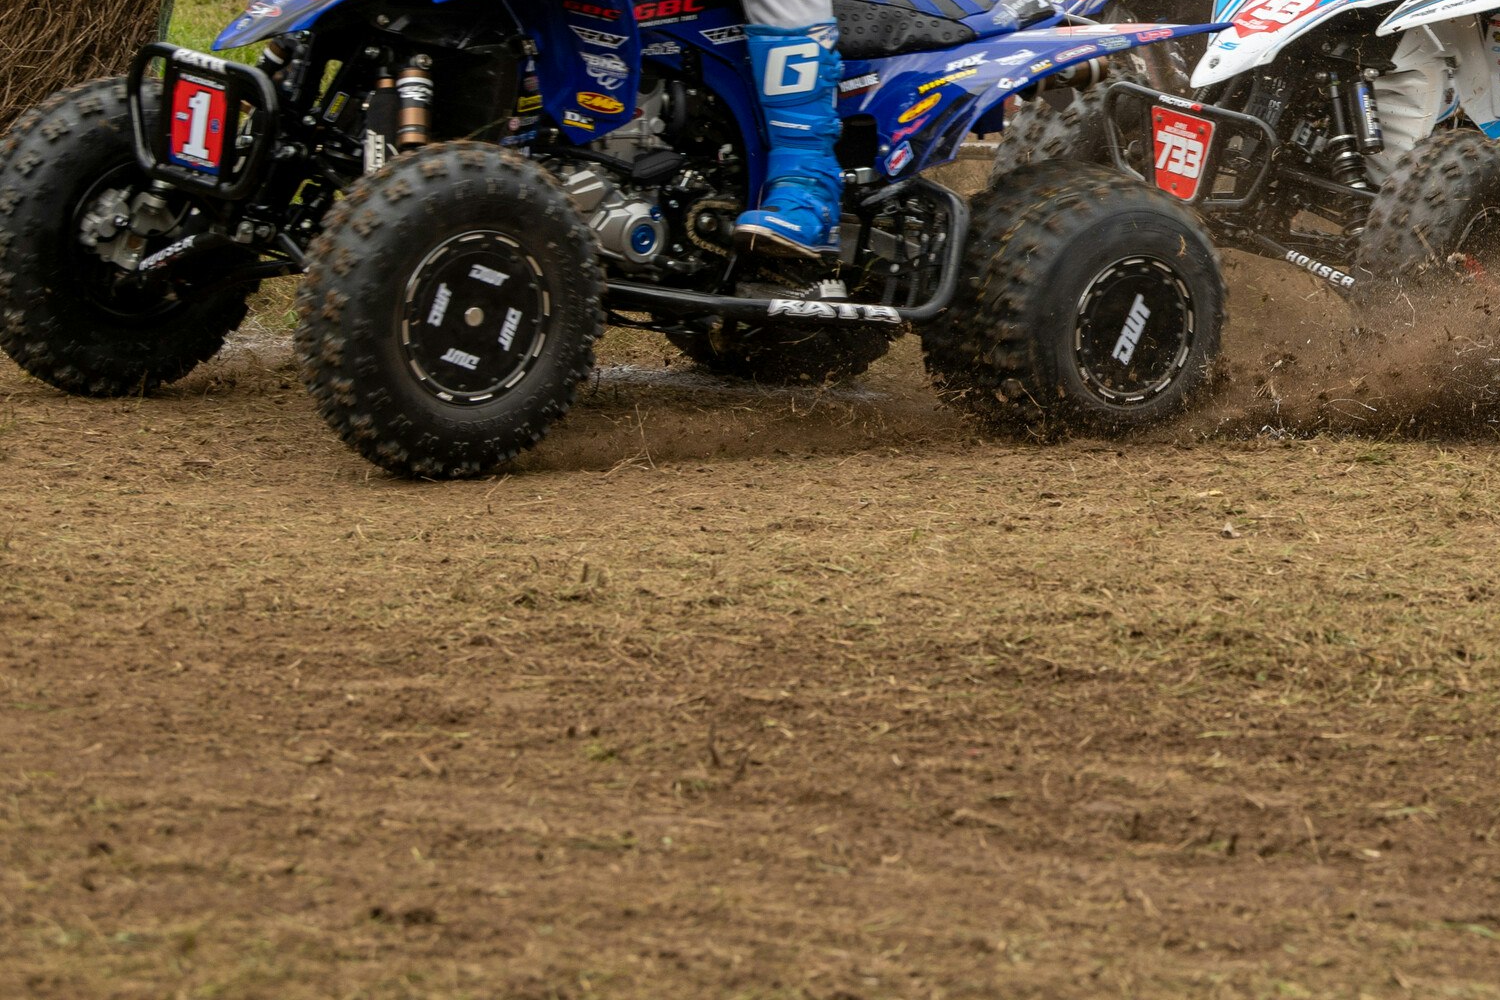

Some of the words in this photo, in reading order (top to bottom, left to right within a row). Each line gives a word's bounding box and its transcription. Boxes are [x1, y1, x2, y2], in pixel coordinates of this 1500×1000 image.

[763, 41, 820, 97] G
[183, 90, 212, 161] 1
[1155, 130, 1204, 179] 733
[1285, 249, 1356, 288] HOUSER
